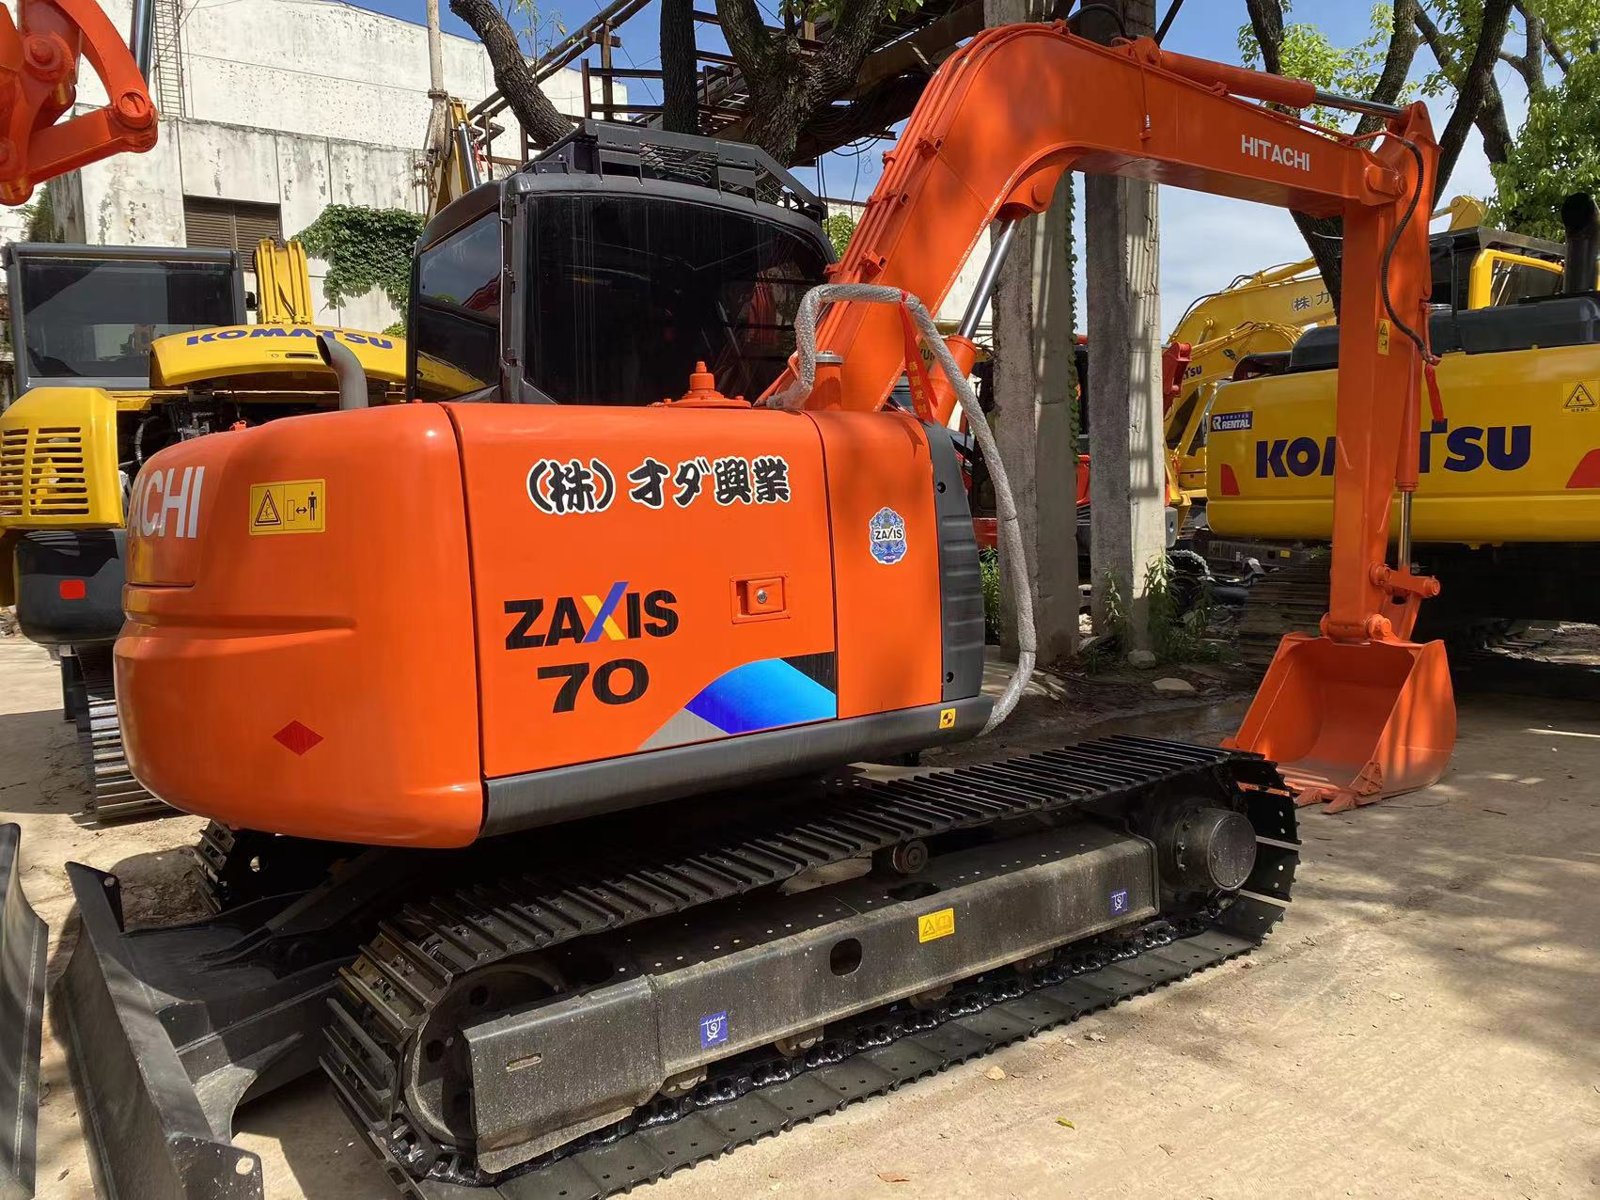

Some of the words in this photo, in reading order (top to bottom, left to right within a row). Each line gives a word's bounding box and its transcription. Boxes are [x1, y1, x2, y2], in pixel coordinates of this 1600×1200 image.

[1241, 134, 1311, 172] HITACHI
[186, 328, 393, 349] KOMATSU
[1222, 419, 1251, 430] RENTAL
[504, 581, 680, 650] ZAXIS
[537, 658, 650, 714] 70
